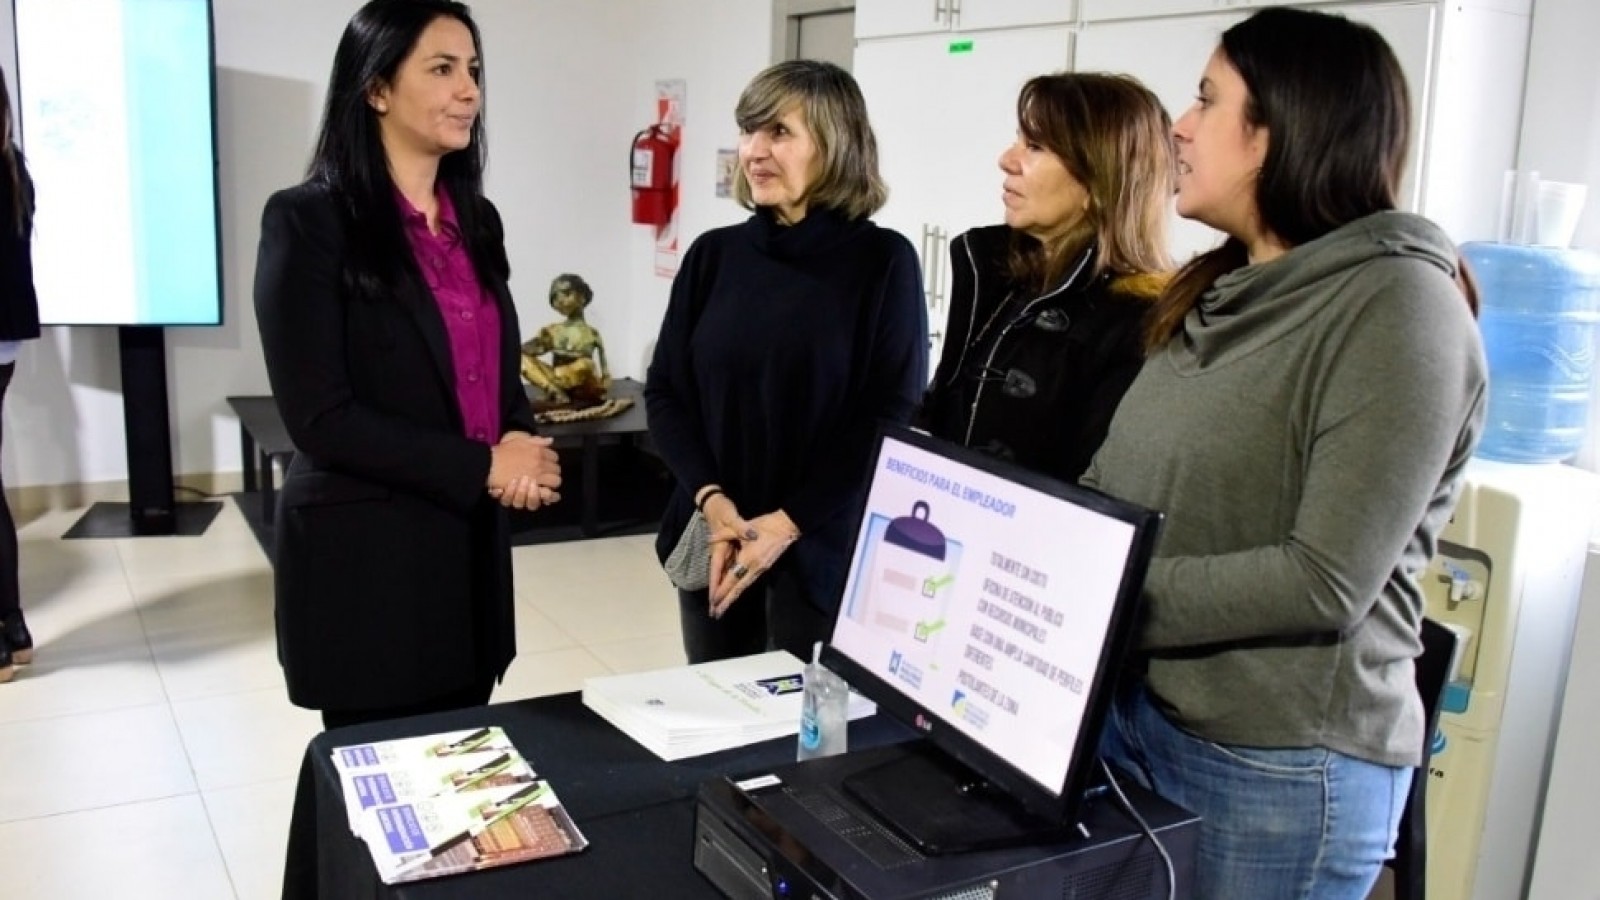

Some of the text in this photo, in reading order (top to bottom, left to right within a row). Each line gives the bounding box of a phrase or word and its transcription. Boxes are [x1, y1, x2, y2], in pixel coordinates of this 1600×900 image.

[886, 457, 1017, 518] BENEFICIOS PARA EL EMPLEADOR
